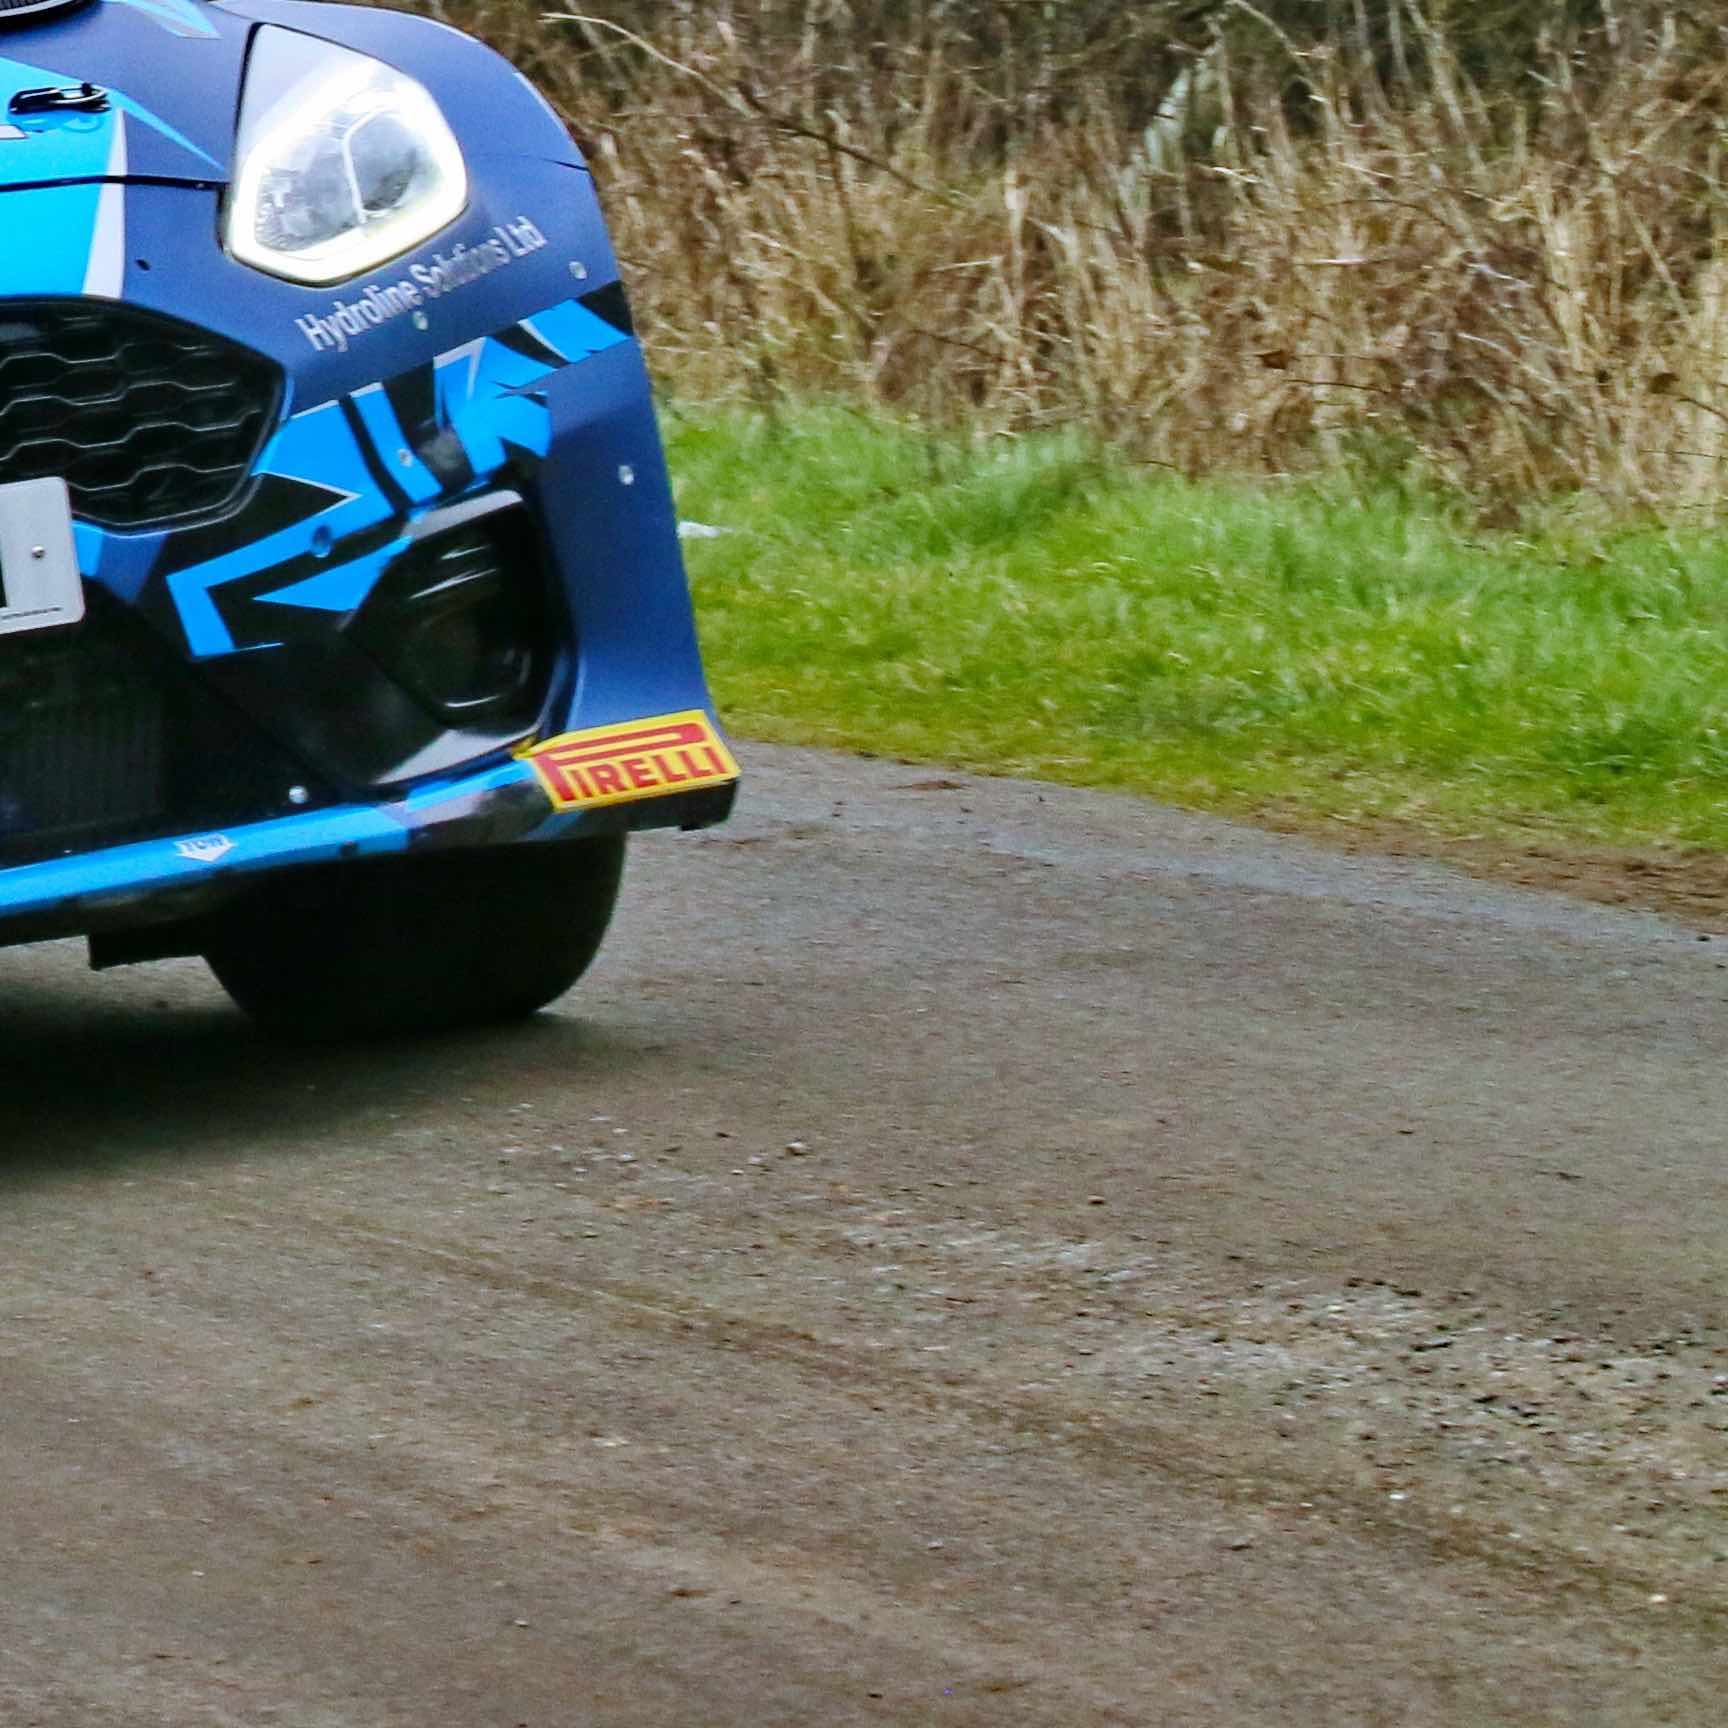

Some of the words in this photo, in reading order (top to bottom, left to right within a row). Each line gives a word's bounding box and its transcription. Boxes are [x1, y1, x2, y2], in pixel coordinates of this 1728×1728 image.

[295, 280, 423, 353] Hydroline
[493, 215, 547, 257] Ltd
[534, 723, 728, 801] PIRELLI
